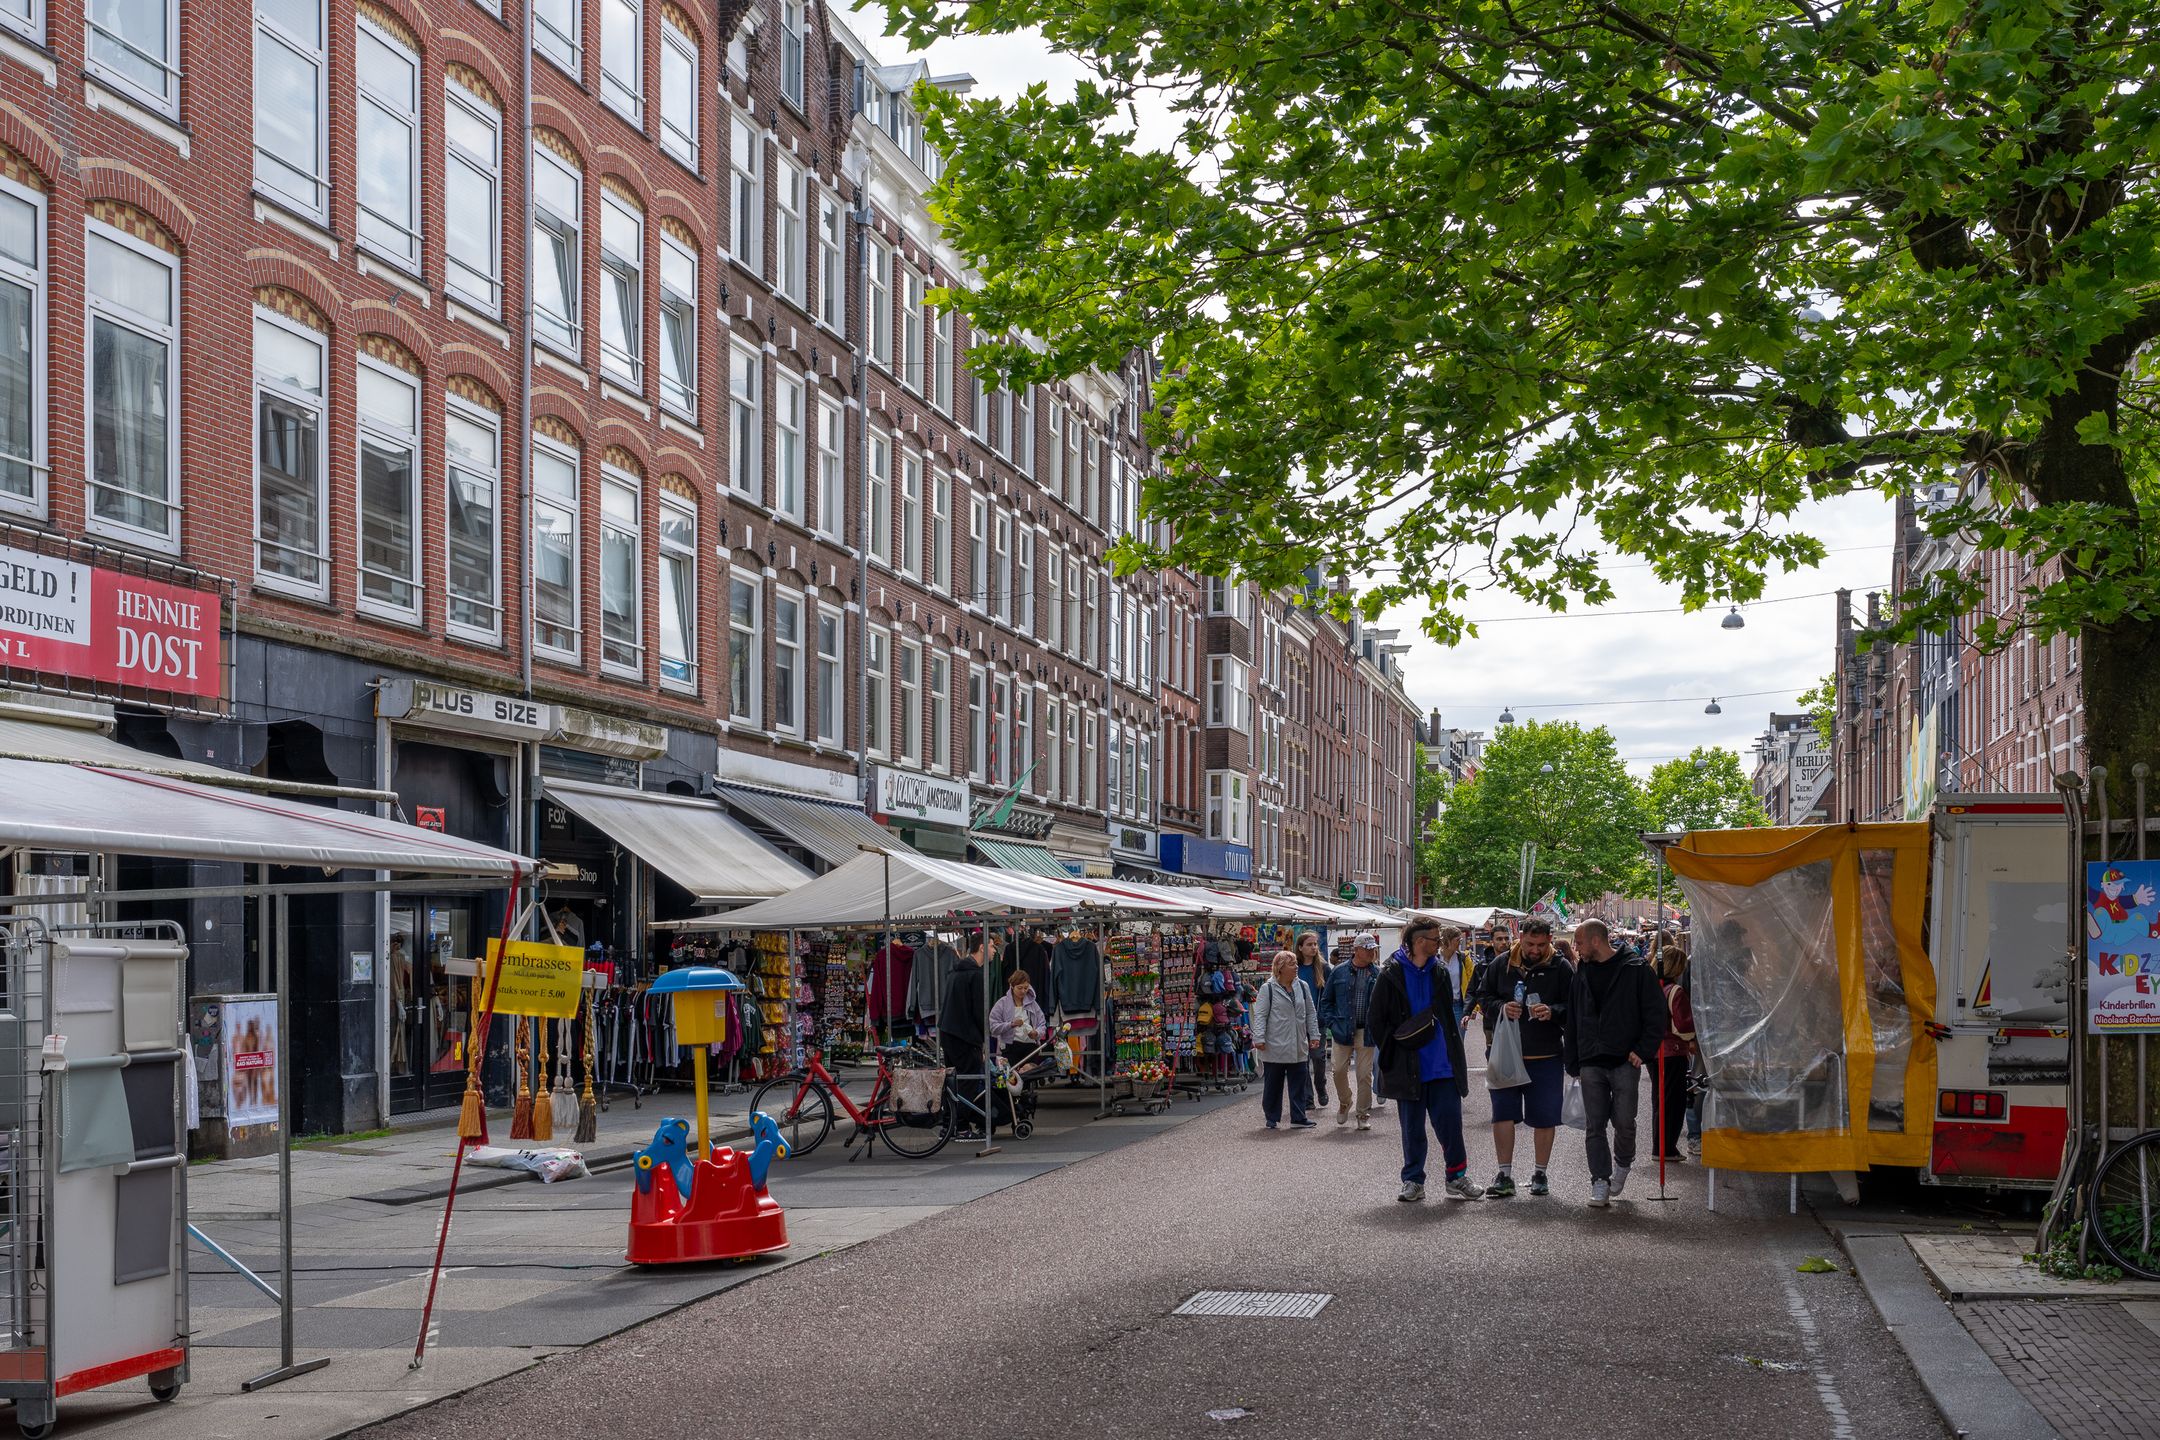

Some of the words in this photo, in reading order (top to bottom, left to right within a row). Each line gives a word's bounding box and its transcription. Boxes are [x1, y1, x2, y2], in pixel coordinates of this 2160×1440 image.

[116, 588, 201, 631] HENNIE
[116, 626, 203, 680] DOST
[418, 685, 474, 714] PLUS
[494, 700, 537, 726] SIZE
[926, 785, 963, 813] AMSTERDAM
[547, 807, 567, 824] FOX
[579, 867, 598, 885] Shop
[501, 952, 572, 972] embrasses
[519, 987, 538, 997] voor
[2099, 1000, 2156, 1010] Kinderbrillen
[2094, 1013, 2128, 1024] Nicolaas
